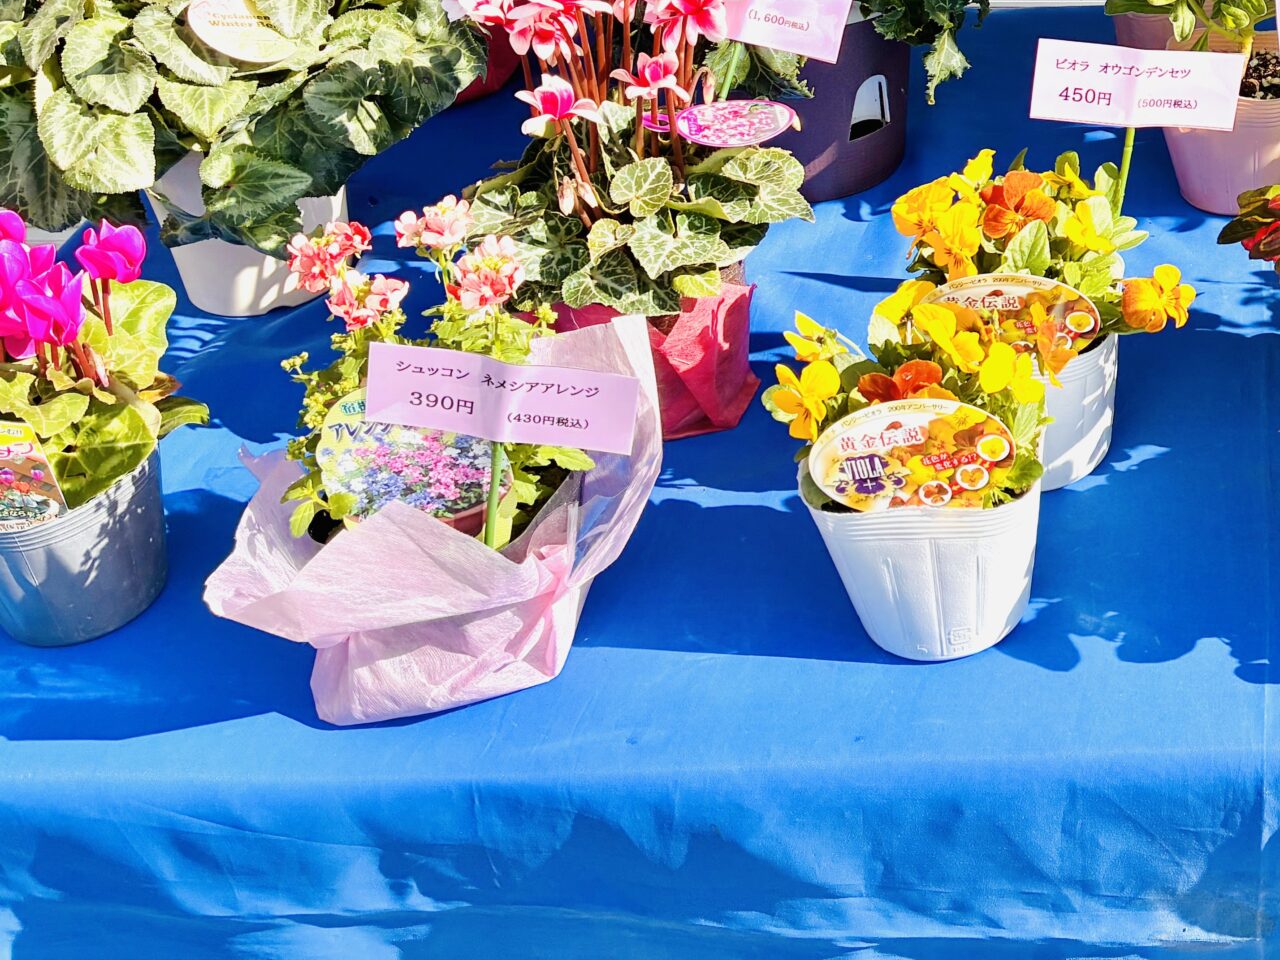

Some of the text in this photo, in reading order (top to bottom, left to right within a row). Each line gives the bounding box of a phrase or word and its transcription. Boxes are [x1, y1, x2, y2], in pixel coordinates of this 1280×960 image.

[748, 8, 811, 32] (1,600円税込)
[1098, 62, 1191, 79] オウゴンデンセツ
[1058, 86, 1198, 110] 450円 (500円税込)
[396, 360, 600, 398] シュッコン ネメシアアレンジ
[409, 391, 590, 430] 390円 (430円税込)
[840, 426, 922, 452] 黄金伝説
[843, 456, 885, 481] VIOLA
